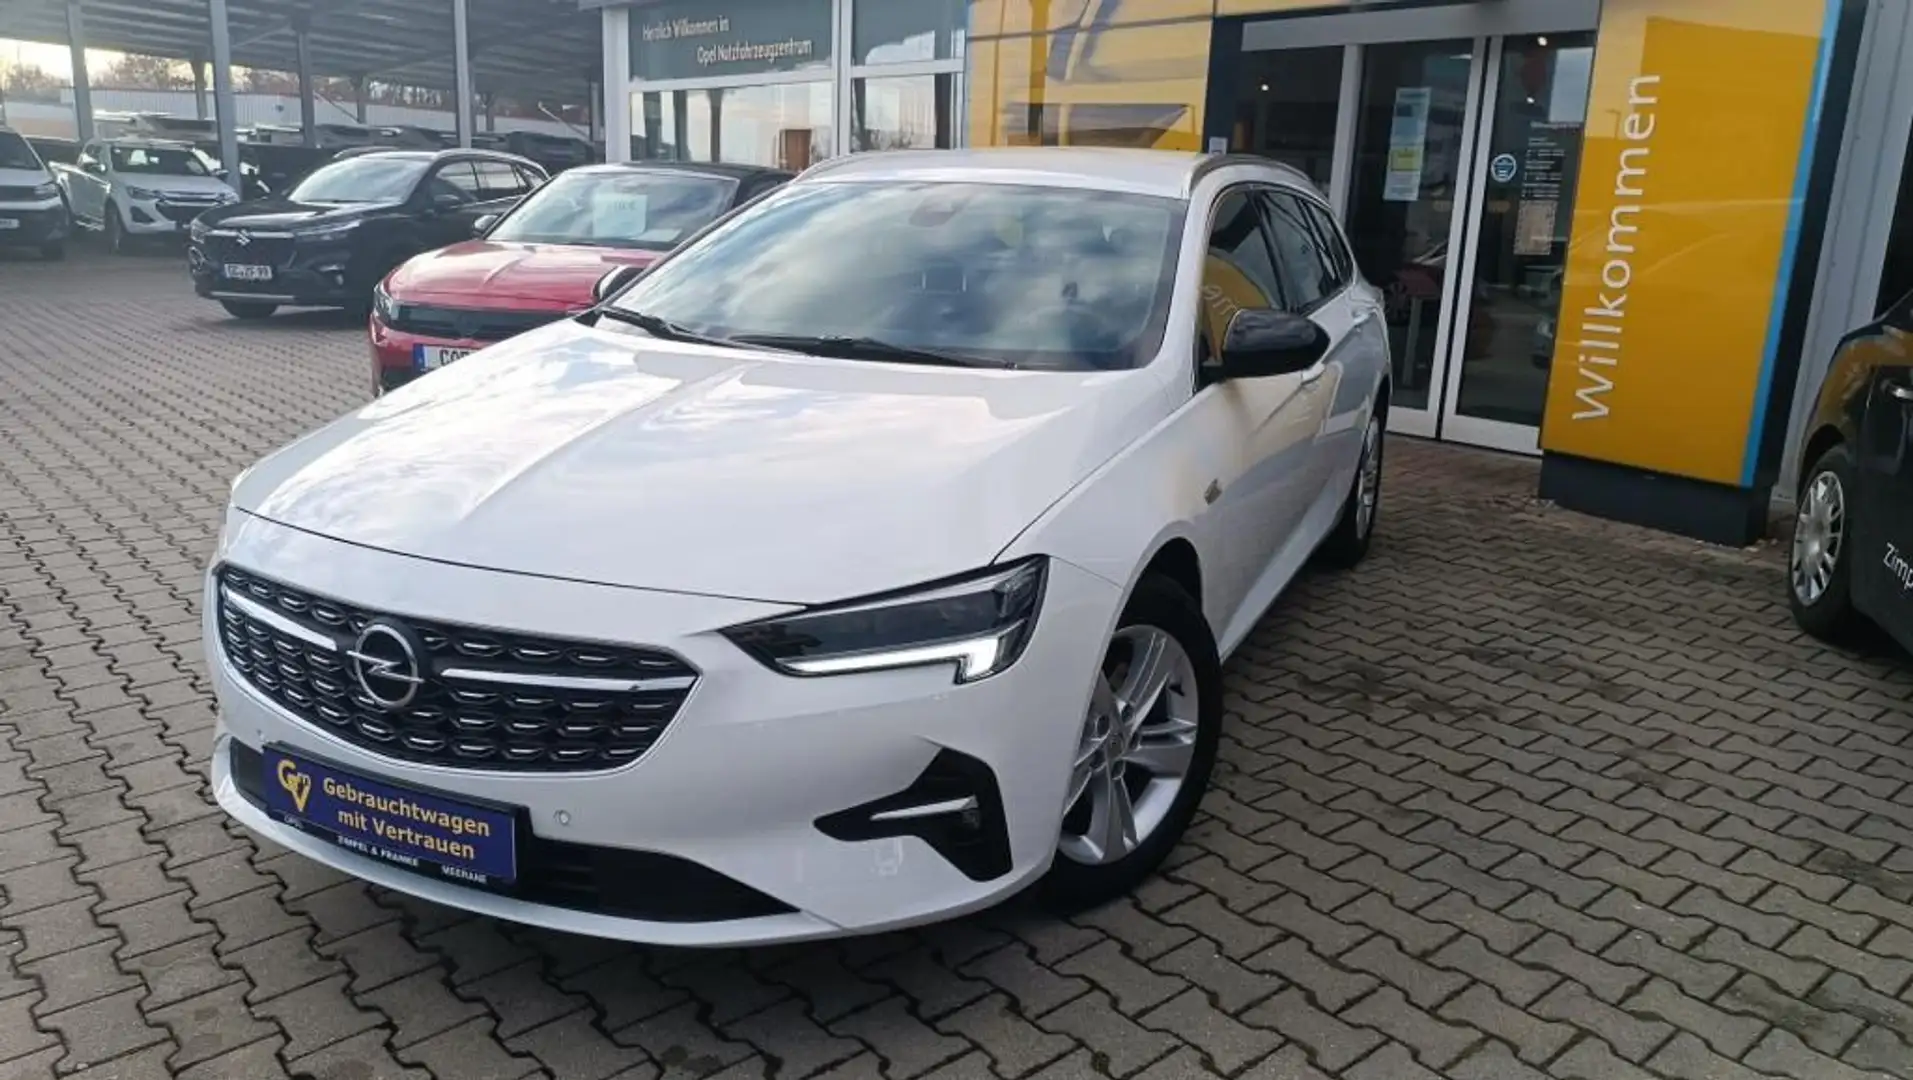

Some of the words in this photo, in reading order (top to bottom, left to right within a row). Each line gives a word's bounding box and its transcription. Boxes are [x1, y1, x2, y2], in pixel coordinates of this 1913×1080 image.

[642, 21, 672, 41] Herzlich
[672, 16, 719, 38] Willkommen
[697, 44, 717, 67] Opel
[718, 37, 812, 64] Nutzfahrzeugzentrum
[1572, 75, 1661, 420] Willkommen
[323, 776, 491, 838] Gebrauchtwagen
[338, 809, 368, 832] mit
[373, 817, 475, 860] Vertrauen
[371, 846, 378, 856] &
[381, 848, 419, 867] FRANKE
[441, 865, 487, 885] MEERANE
